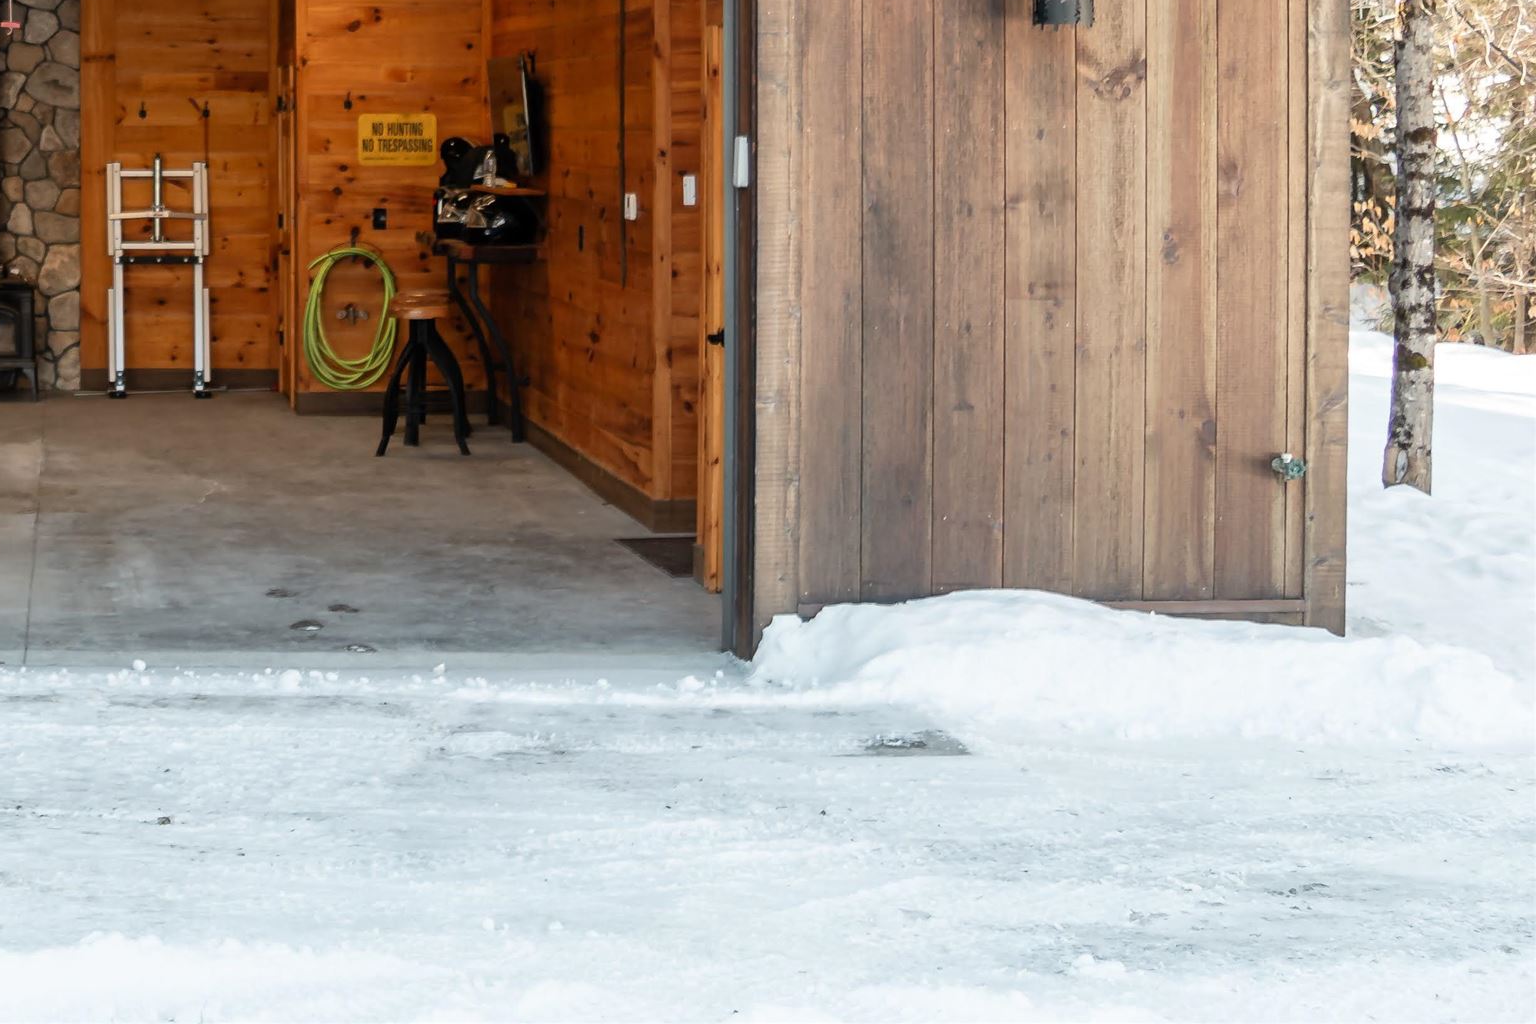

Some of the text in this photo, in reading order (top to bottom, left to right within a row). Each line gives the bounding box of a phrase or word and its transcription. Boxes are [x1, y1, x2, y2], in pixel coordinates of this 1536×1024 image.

[372, 122, 423, 136] NO HUNTING
[362, 139, 432, 152] NO TRESPASSING
